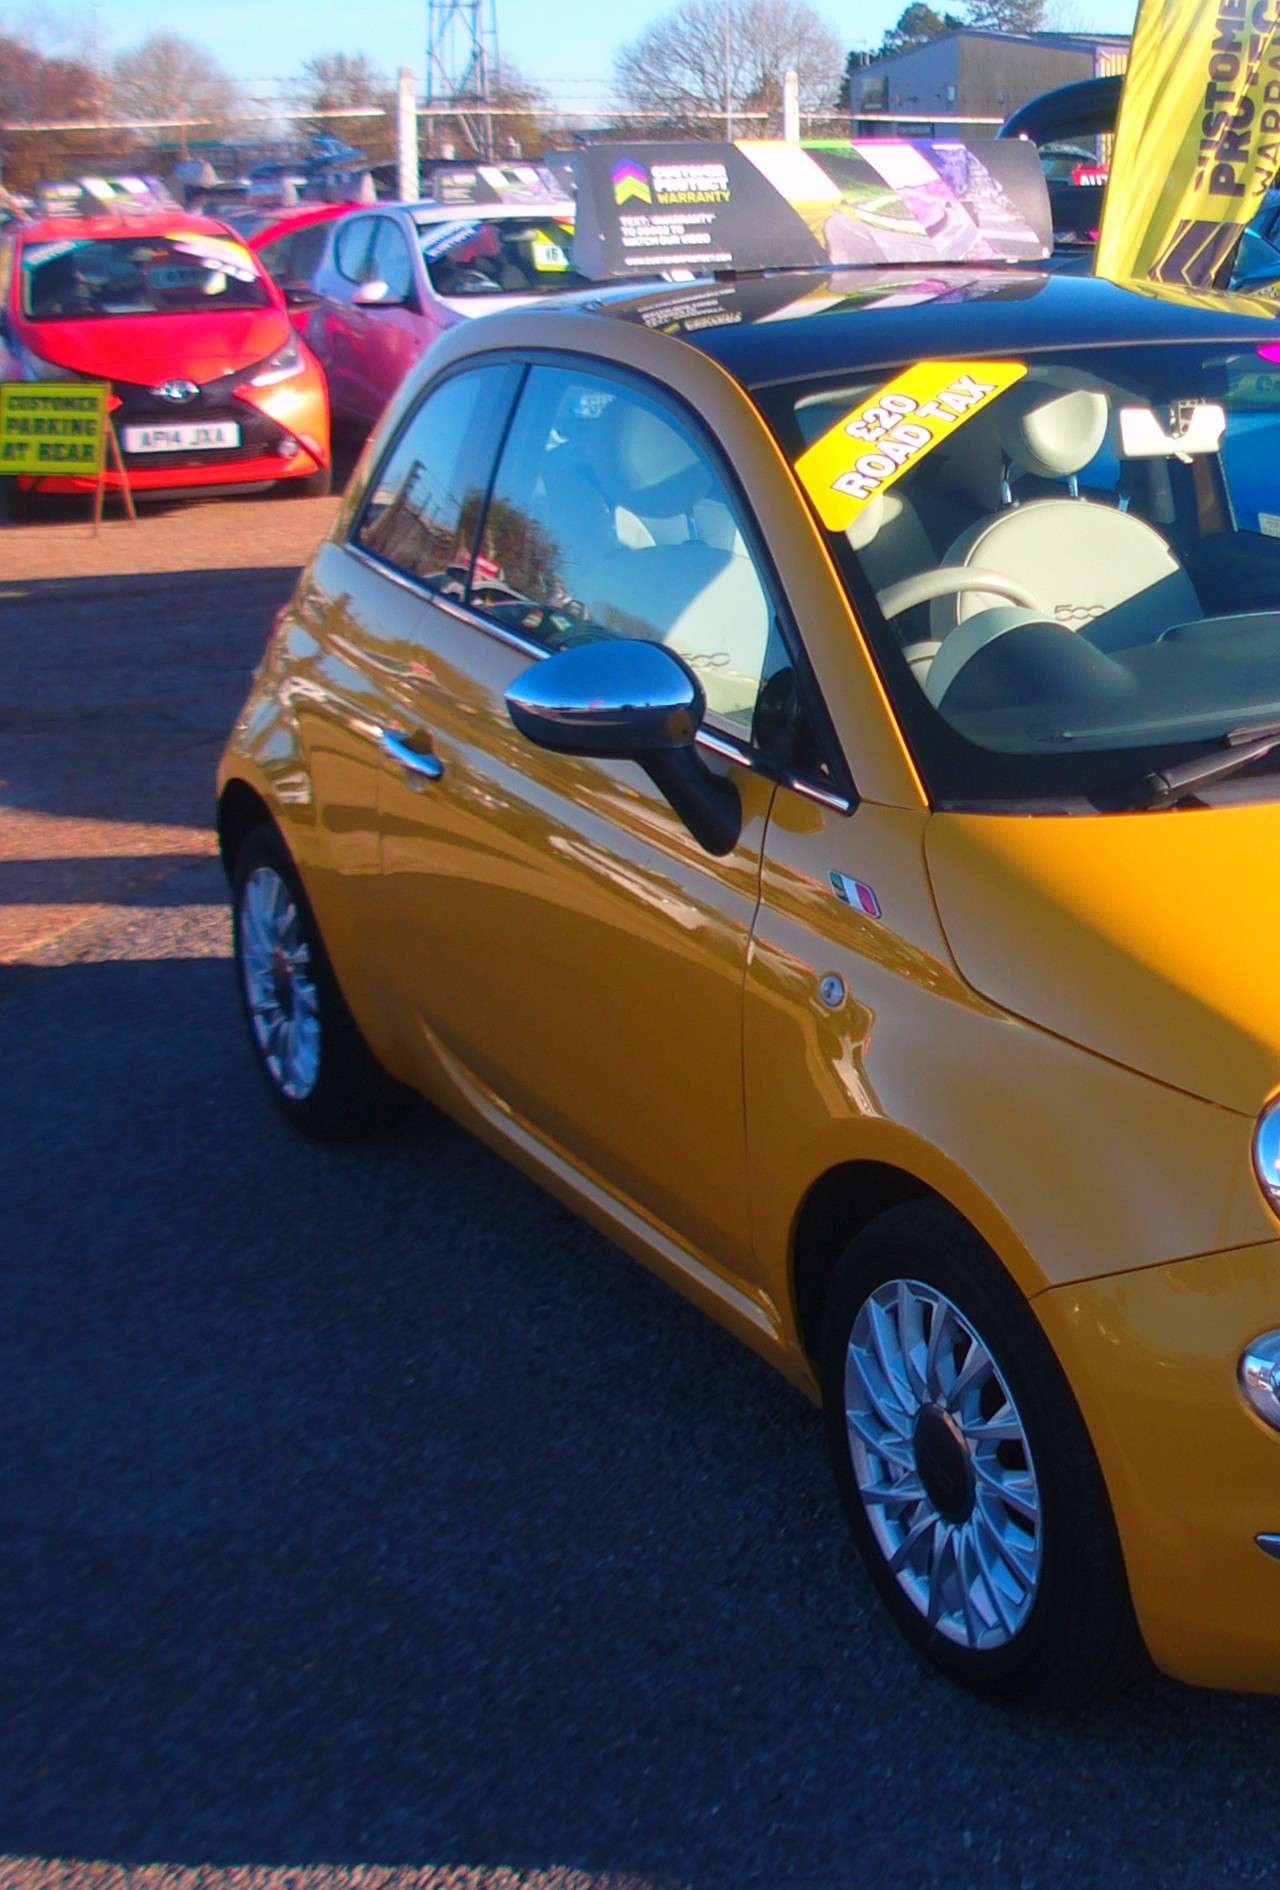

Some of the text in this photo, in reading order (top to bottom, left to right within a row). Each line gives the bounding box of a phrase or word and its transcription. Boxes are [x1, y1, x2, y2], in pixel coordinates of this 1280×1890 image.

[653, 176, 729, 191] PROTECT
[656, 190, 731, 204] WARRANTY
[6, 418, 97, 435] PARKING
[845, 394, 919, 443] £20
[831, 374, 999, 500] ROAD TAX
[2, 443, 95, 461] AT REAR
